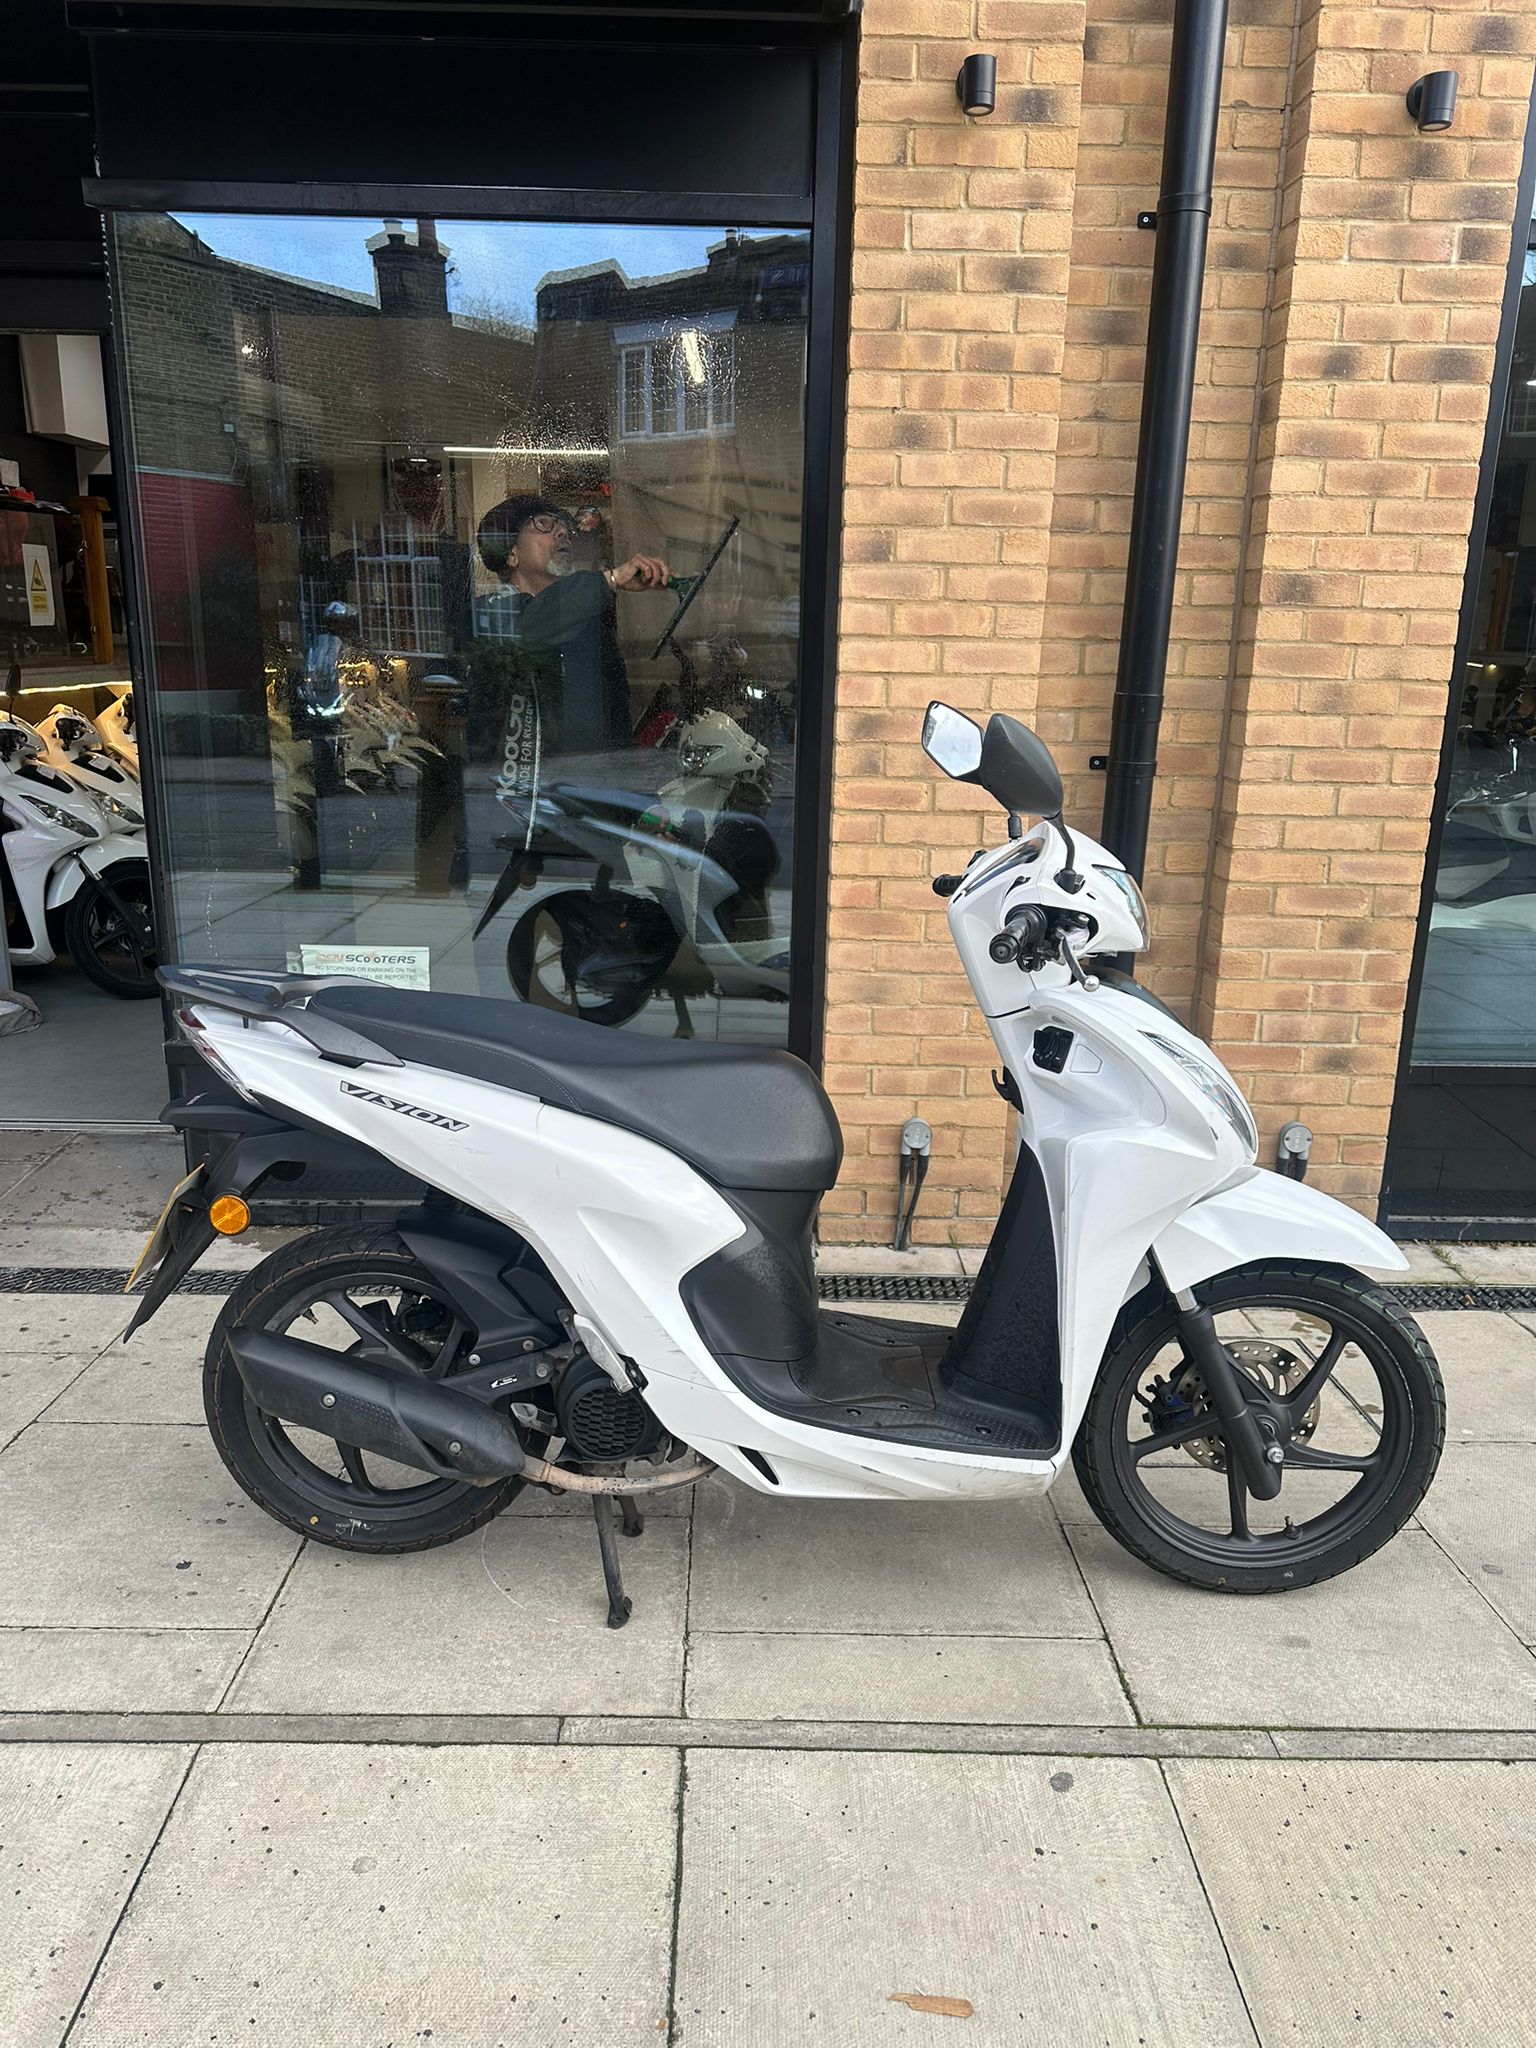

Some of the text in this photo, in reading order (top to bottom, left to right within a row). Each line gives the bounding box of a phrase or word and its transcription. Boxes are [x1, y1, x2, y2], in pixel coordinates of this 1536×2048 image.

[518, 701, 535, 796] MADE FOR RUGBY
[340, 1080, 470, 1132] VISION
